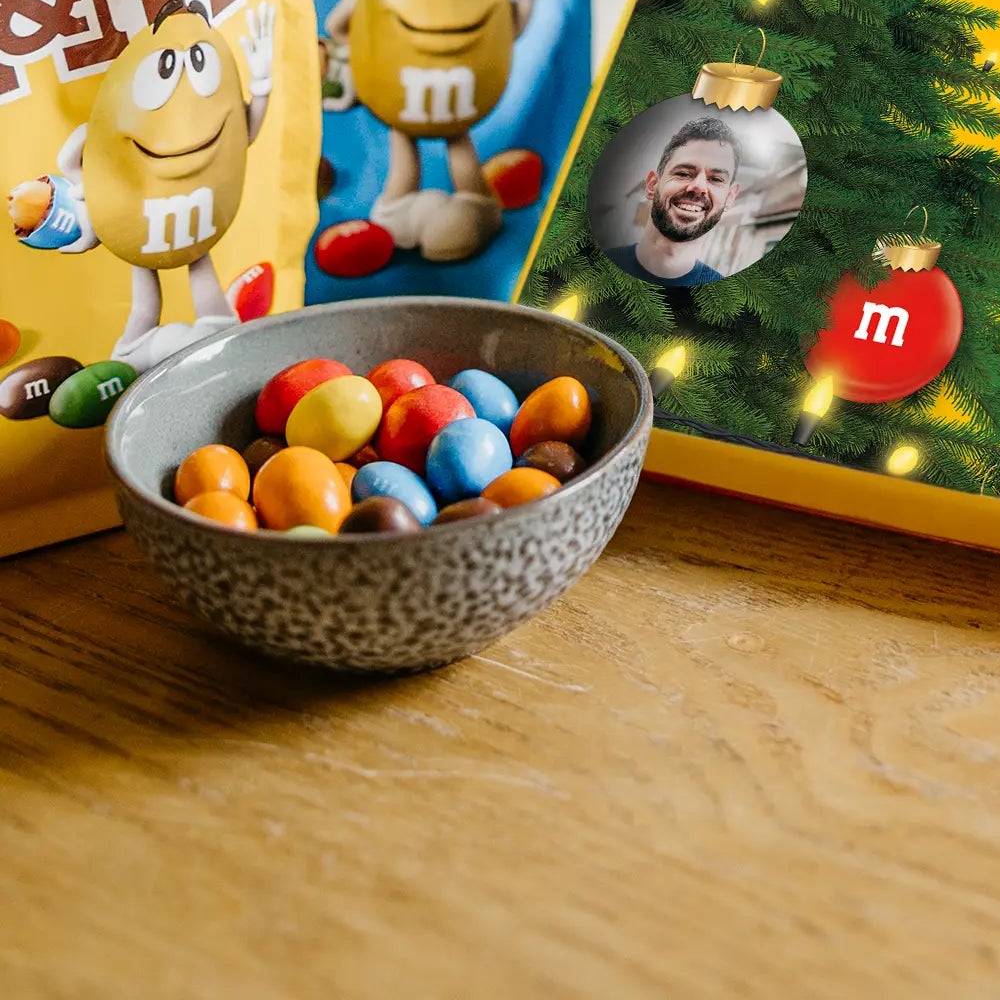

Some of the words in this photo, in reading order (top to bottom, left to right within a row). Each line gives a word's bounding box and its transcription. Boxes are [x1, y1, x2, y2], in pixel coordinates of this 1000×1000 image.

[398, 66, 478, 123] m
[51, 207, 77, 234] m
[141, 186, 216, 254] m
[853, 301, 910, 347] m
[24, 378, 51, 400] m
[97, 376, 124, 401] m
